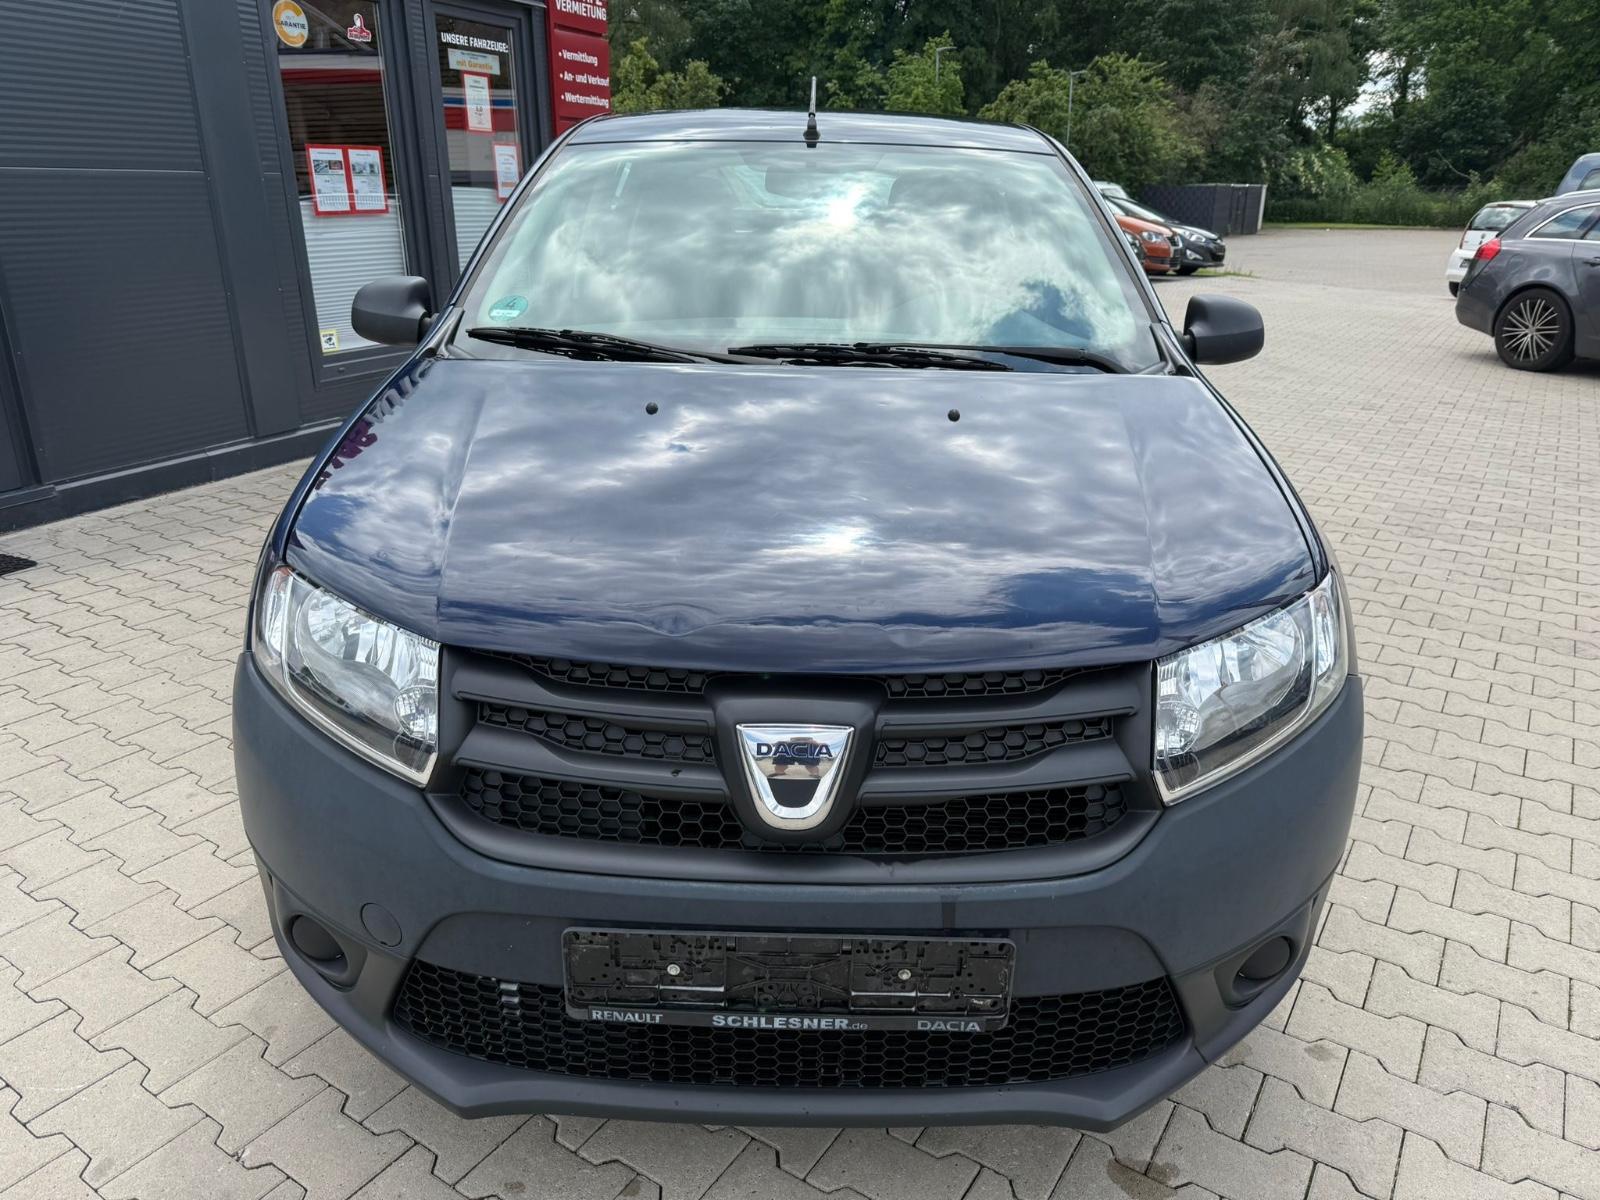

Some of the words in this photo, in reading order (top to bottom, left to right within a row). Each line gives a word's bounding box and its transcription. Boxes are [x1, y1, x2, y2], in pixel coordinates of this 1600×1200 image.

[555, 0, 607, 21] VERMIETUNG
[441, 32, 469, 47] UNSERE
[469, 37, 509, 53] FAHRZEUGE:
[562, 49, 598, 67] Vermittlung
[564, 71, 575, 81] An-
[575, 73, 587, 84] und
[565, 92, 609, 109] Wertermittlung
[505, 297, 518, 311] 4
[756, 743, 833, 758] DACIA
[592, 1010, 663, 1023] RENAULT
[712, 1015, 868, 1030] SCHLESNER.de
[917, 1020, 981, 1031] DACIA
